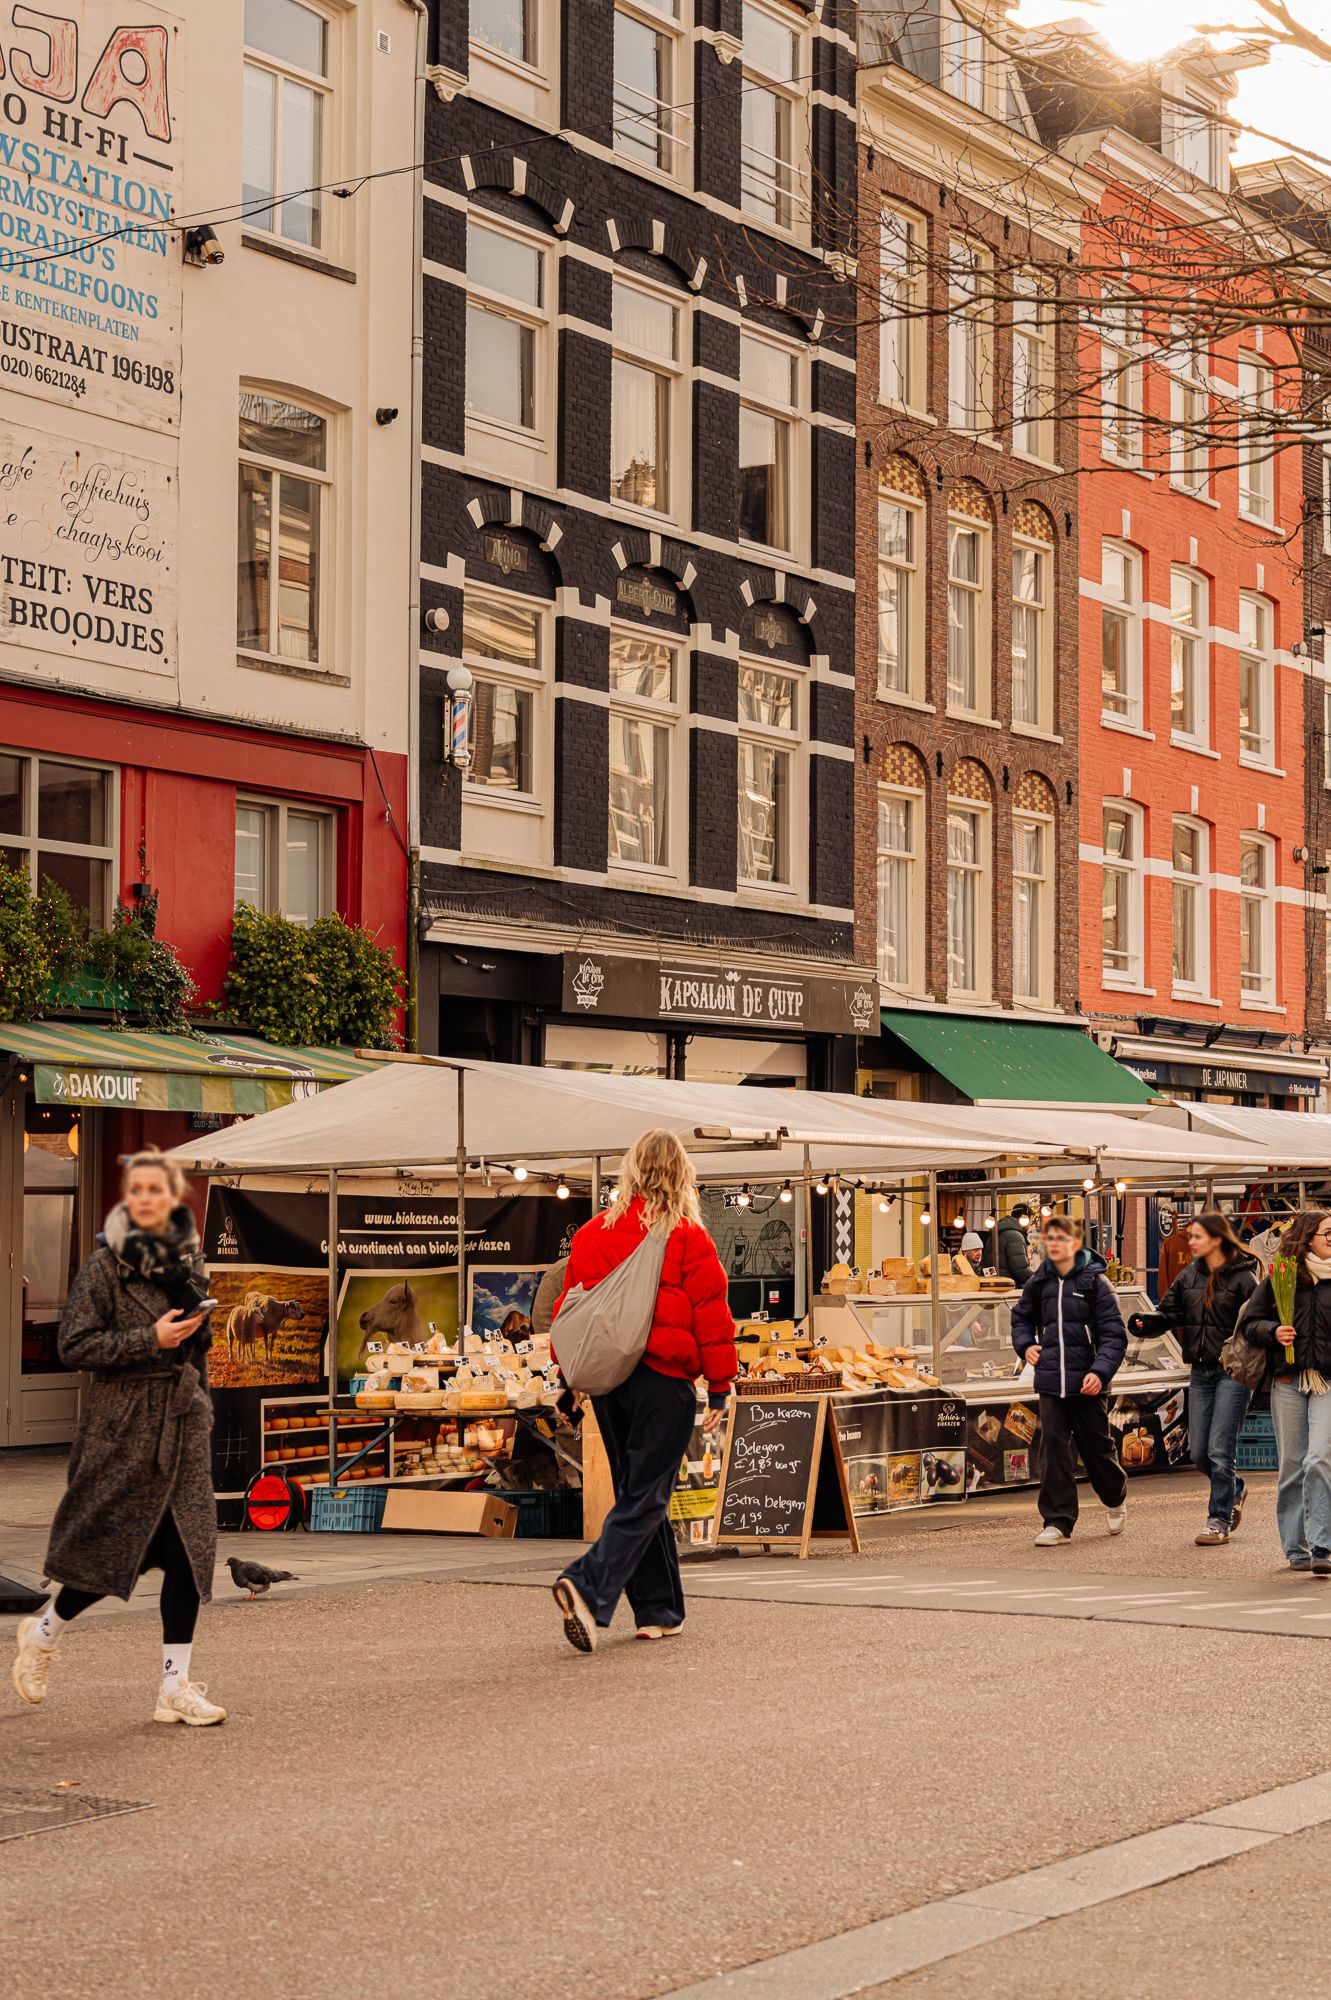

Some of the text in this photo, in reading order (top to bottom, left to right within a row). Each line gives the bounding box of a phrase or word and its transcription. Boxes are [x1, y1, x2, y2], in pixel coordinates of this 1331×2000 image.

[0, 4, 172, 144] JA
[15, 289, 139, 341] KENTEKENPLATEN
[0, 320, 108, 374] USTRAAT
[0, 355, 86, 395] 020) 6621284
[491, 539, 521, 566] ANNO
[83, 574, 153, 615] VERS
[8, 596, 164, 655] BROODJES
[659, 976, 736, 1011] KAPSALON
[768, 986, 804, 1019] CUYP
[69, 1073, 142, 1101] DAKDUIF
[1202, 1068, 1212, 1086] DE
[1213, 1069, 1248, 1089] JAPANNER
[1293, 1084, 1316, 1096] Heineken
[364, 1212, 466, 1225] www.biokazen.co
[320, 1239, 347, 1254] Got
[348, 1241, 404, 1255] assortiment
[406, 1242, 427, 1255] aan
[478, 1238, 511, 1251] kazen
[735, 1437, 785, 1458] Belegen
[725, 1494, 761, 1507] Extra
